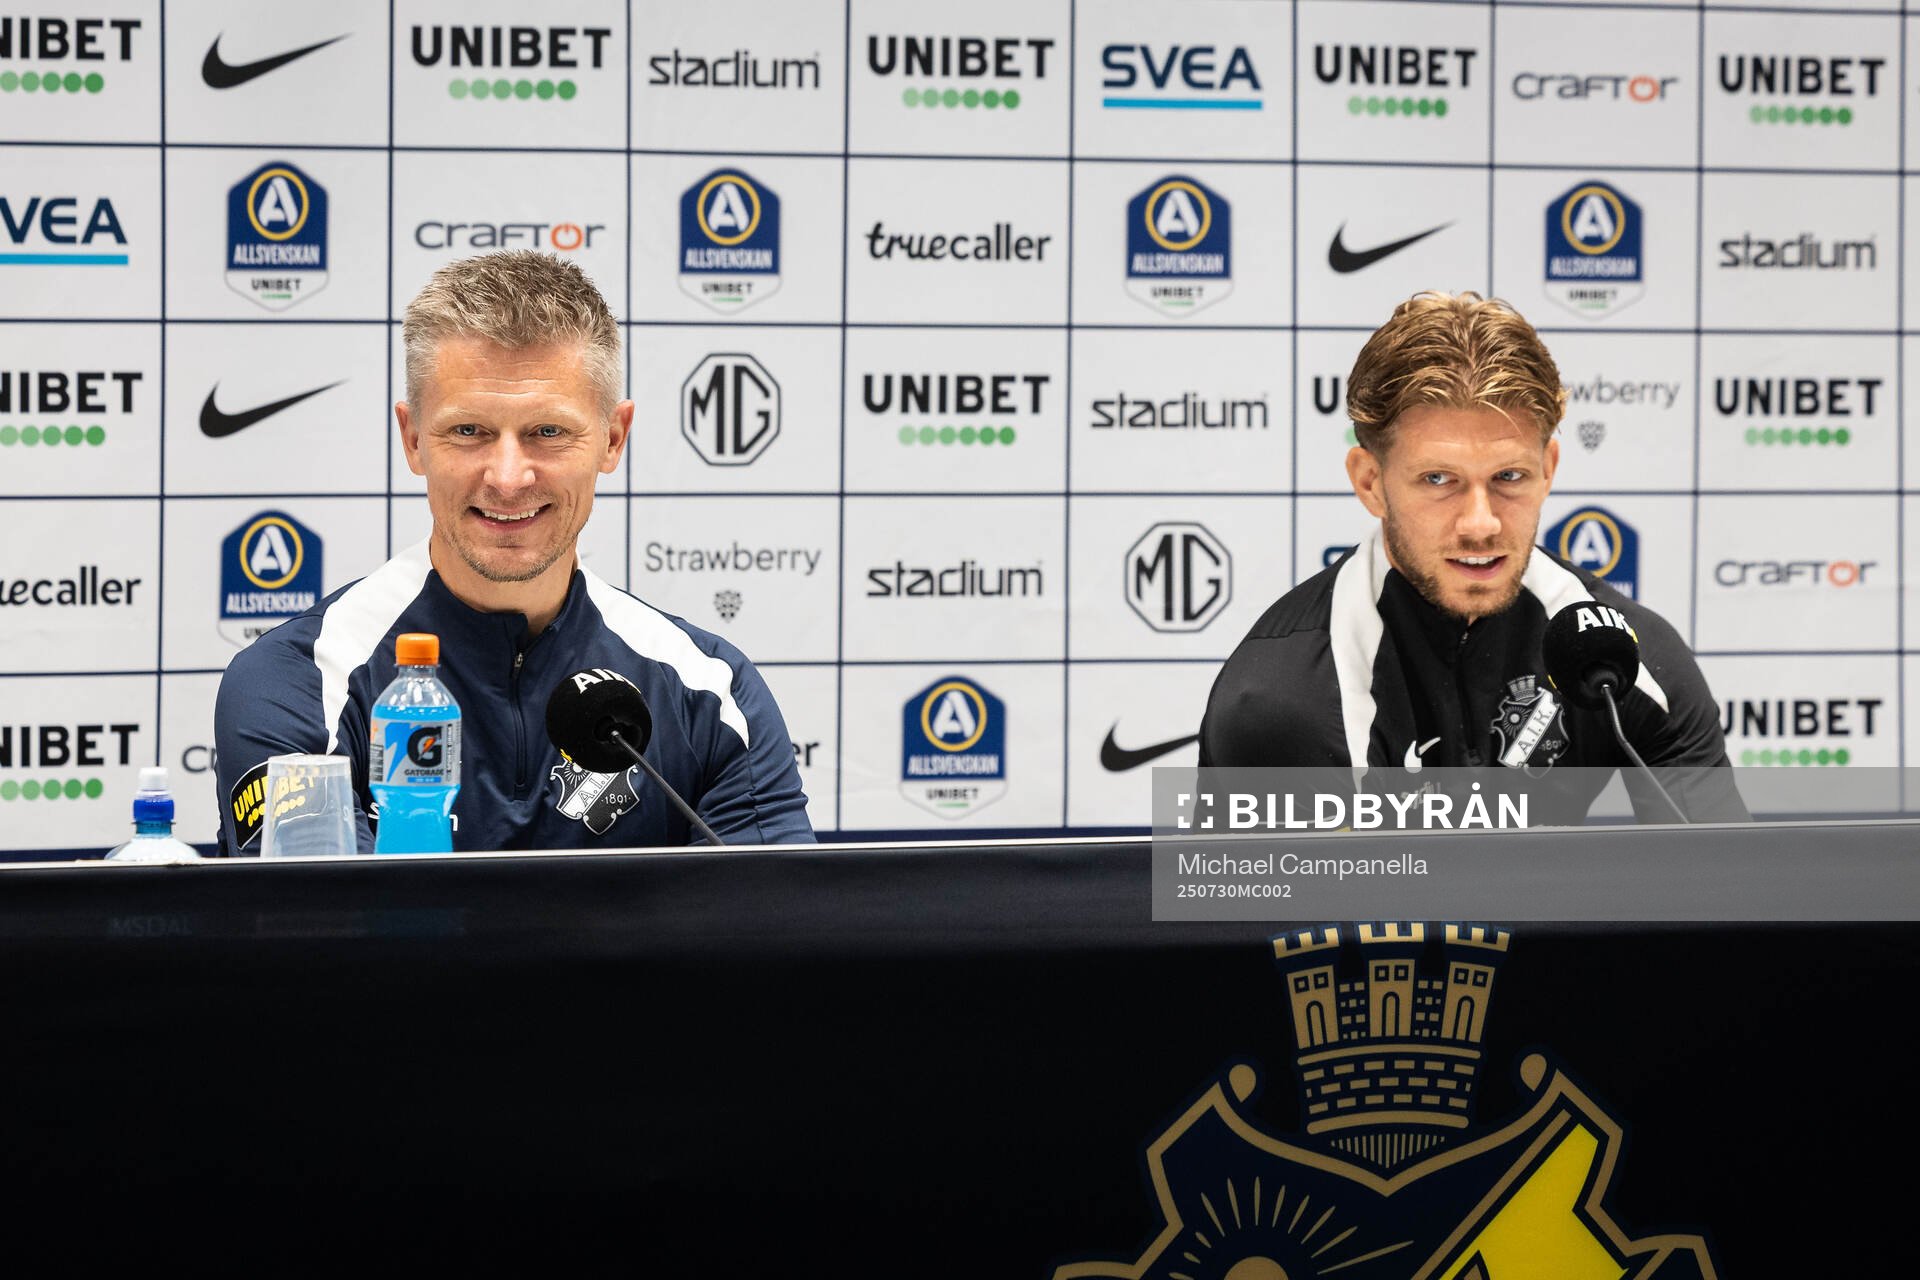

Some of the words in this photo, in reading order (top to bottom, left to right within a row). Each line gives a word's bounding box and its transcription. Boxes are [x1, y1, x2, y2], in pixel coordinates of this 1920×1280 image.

[0, 17, 142, 61] IBET
[411, 25, 612, 70] UNIBET
[867, 35, 1056, 79] UNIBET
[648, 48, 820, 89] stadium
[1101, 44, 1262, 91] SVEA
[1314, 44, 1478, 88] UNIBET
[1718, 54, 1886, 97] UNIBET
[0, 196, 128, 245] VEA
[233, 244, 320, 265] ALLSVENSKAN
[685, 248, 773, 269] ALLSVENSKAN
[865, 221, 1052, 262] truecaller
[1719, 233, 1877, 270] stadium
[1132, 253, 1224, 273] ALLSVENSKAN
[251, 278, 301, 291] UNIBET
[702, 281, 753, 295] UNIBET
[1151, 285, 1204, 299] UNIBET
[0, 371, 143, 414] IBET
[688, 363, 772, 457] MG
[863, 373, 1051, 415] UNIBET
[1090, 392, 1269, 429] stadium
[1566, 375, 1681, 409] wberry
[1714, 377, 1883, 417] UNIBET
[645, 541, 822, 576] Strawberry
[1135, 533, 1224, 622] MG
[0, 565, 142, 606] ecaller
[866, 560, 1043, 598] stadium
[0, 723, 140, 768] IBET
[907, 754, 999, 775] ALLSVENSKAN
[604, 793, 628, 805] 1891
[926, 787, 979, 801] UNIBET
